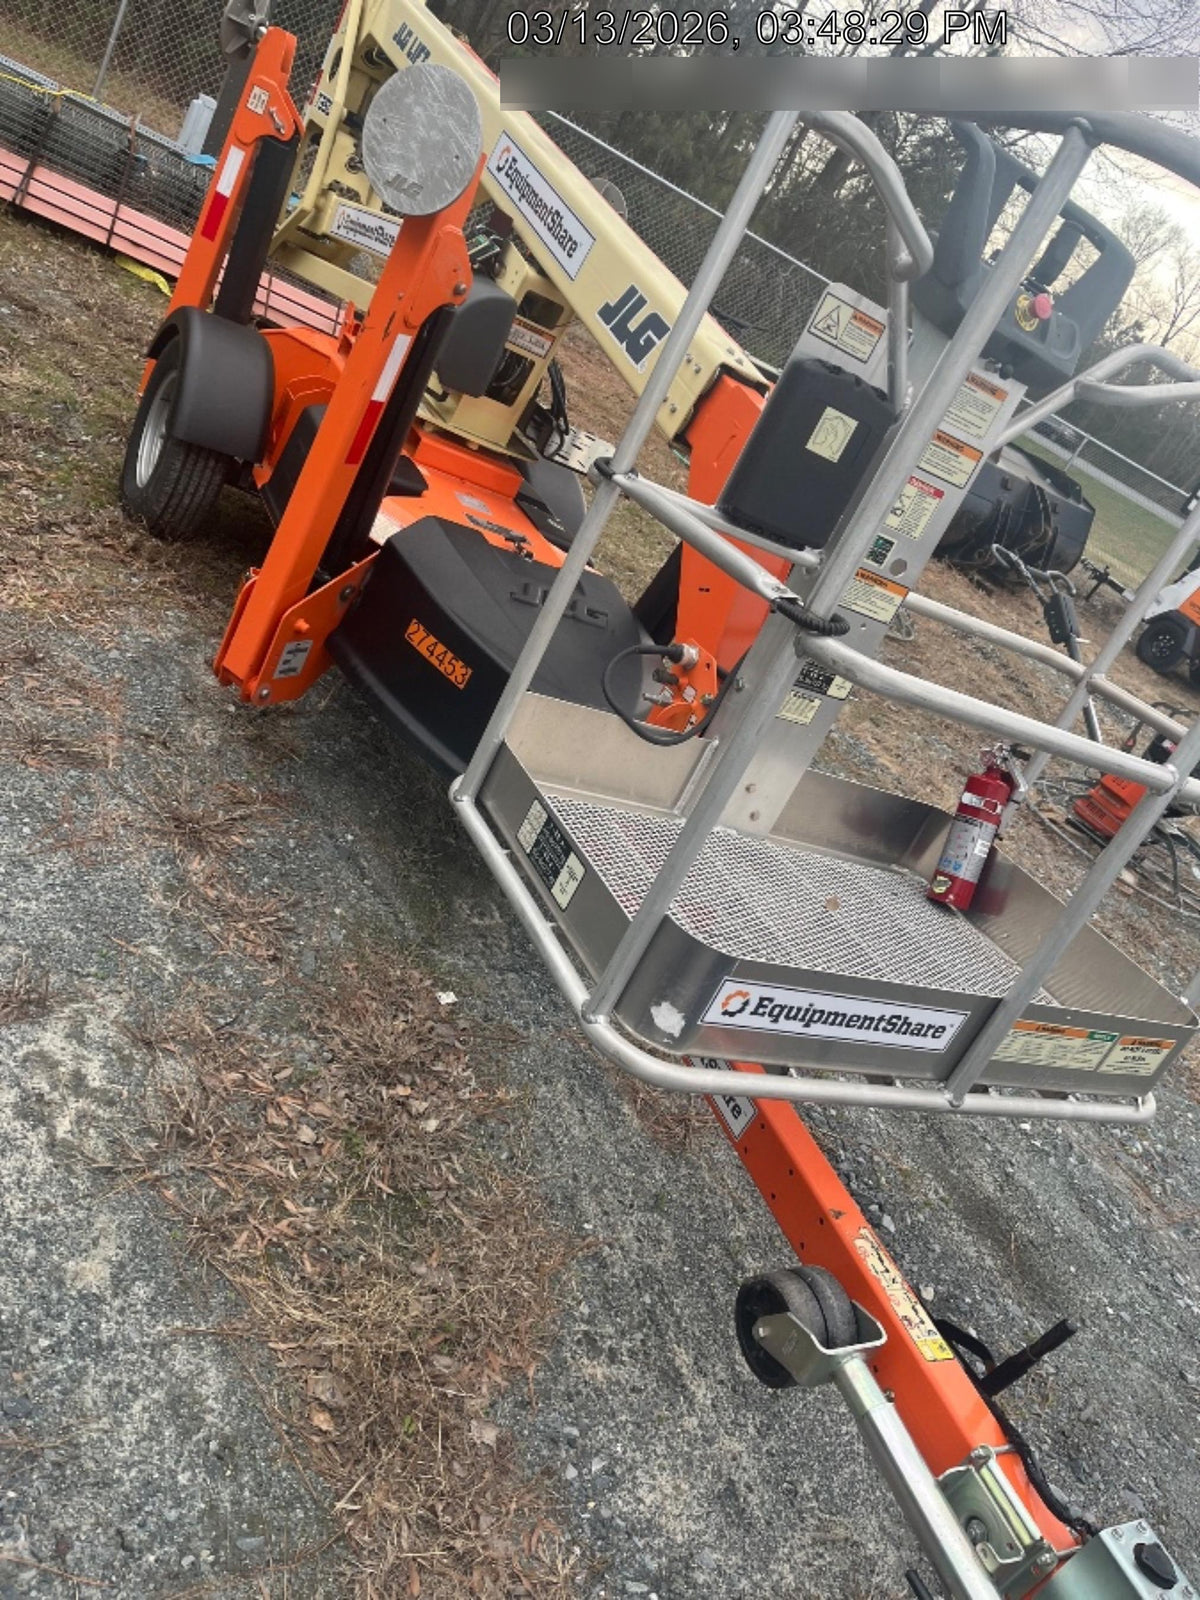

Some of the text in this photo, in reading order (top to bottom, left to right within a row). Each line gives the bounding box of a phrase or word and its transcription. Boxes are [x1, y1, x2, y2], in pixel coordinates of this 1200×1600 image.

[507, 156, 580, 260] EquipmentShare
[597, 284, 671, 367] JLG
[406, 621, 470, 685] 274453
[748, 995, 946, 1041] EquipmentShare
